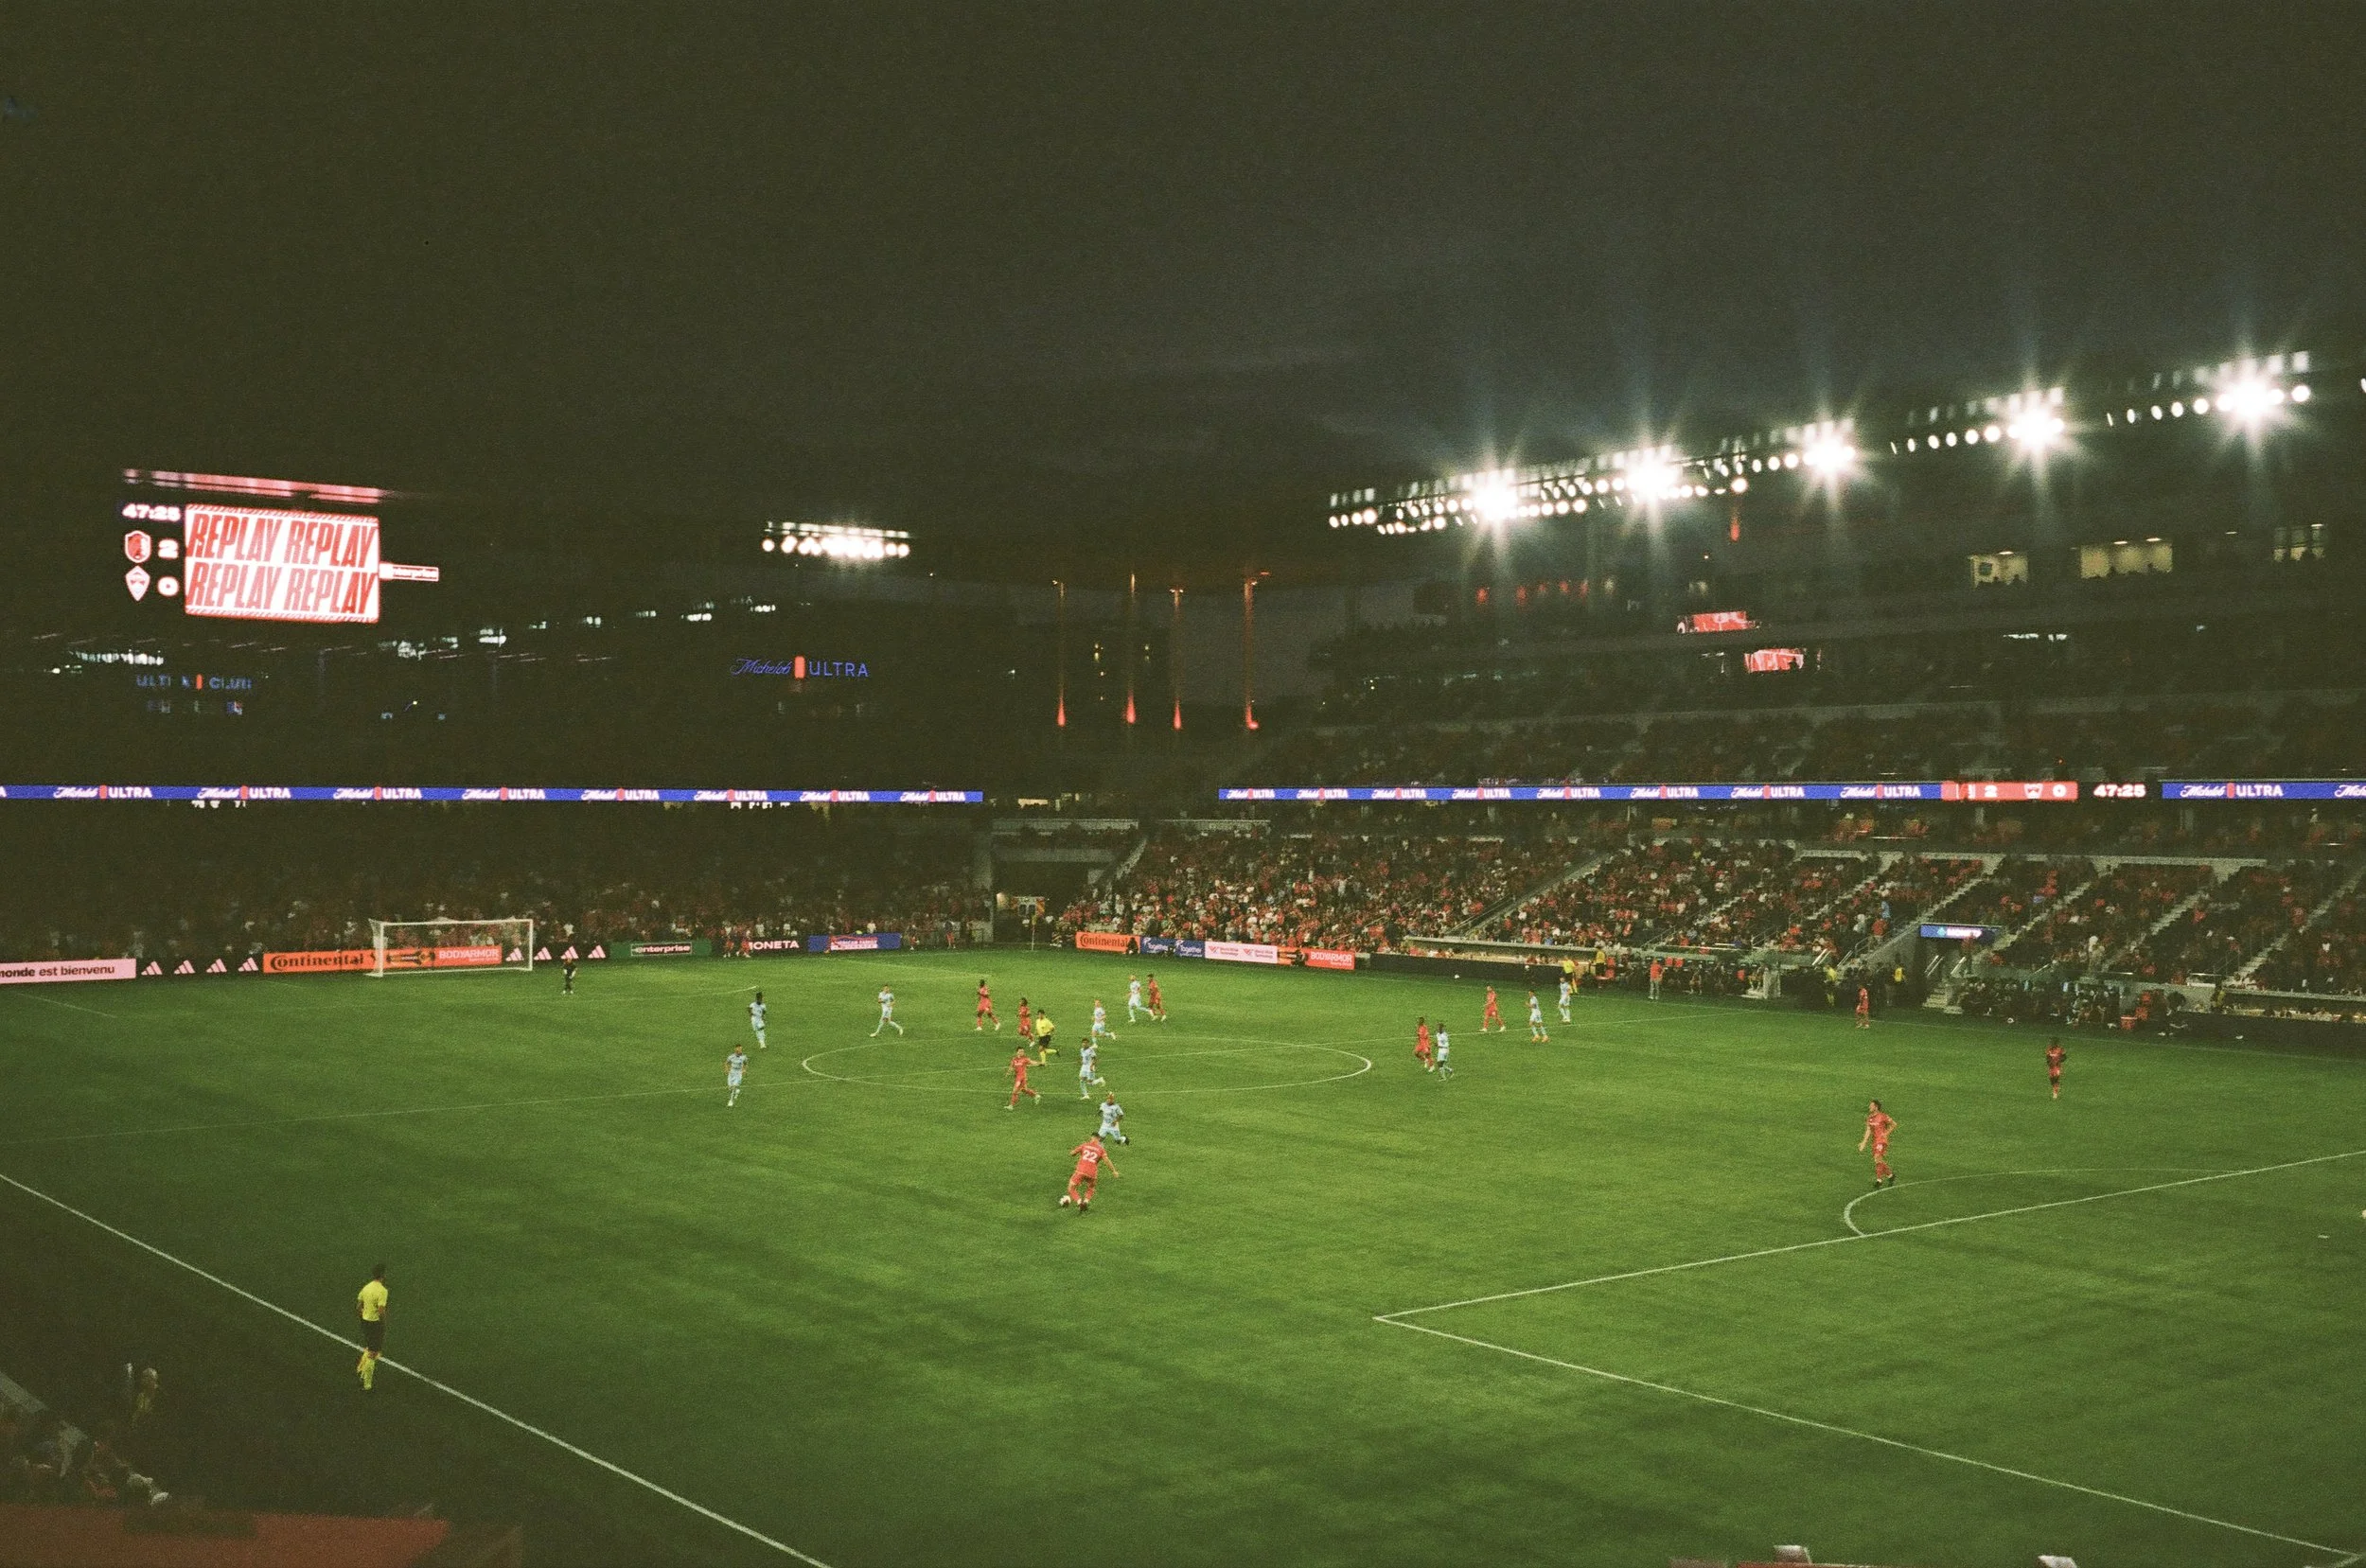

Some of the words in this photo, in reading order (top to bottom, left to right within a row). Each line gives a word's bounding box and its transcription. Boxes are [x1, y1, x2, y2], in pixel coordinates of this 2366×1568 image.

[186, 513, 283, 562] REPLAY
[283, 520, 379, 568] REPLAY
[157, 538, 178, 558] 2
[157, 576, 178, 596] 0
[185, 561, 282, 609] REPLAY
[283, 568, 379, 614] REPLAY
[809, 661, 869, 678] ULTRA
[109, 786, 152, 798] ULTRA
[249, 787, 291, 799] ULTRA
[382, 788, 422, 799] ULTRA
[508, 789, 546, 799] ULTRA
[625, 790, 660, 800] ULTRA
[734, 790, 768, 801] ULTRA
[838, 791, 870, 801] ULTRA
[935, 791, 965, 802] ULTRA
[1667, 787, 1699, 798] ULTRA
[1770, 786, 1805, 798] ULTRA
[1884, 786, 1921, 798] ULTRA
[1984, 784, 1999, 799] 2
[2052, 784, 2068, 798] 0
[2093, 784, 2146, 798] 47:25
[2236, 784, 2284, 797] ULTRA
[439, 948, 500, 960] BODYARMOR
[1311, 951, 1353, 962] BODYARMOR
[271, 953, 364, 971] Continental
[39, 966, 58, 977] est
[61, 964, 115, 976] bienvenu
[1082, 1150, 1099, 1164] 22
